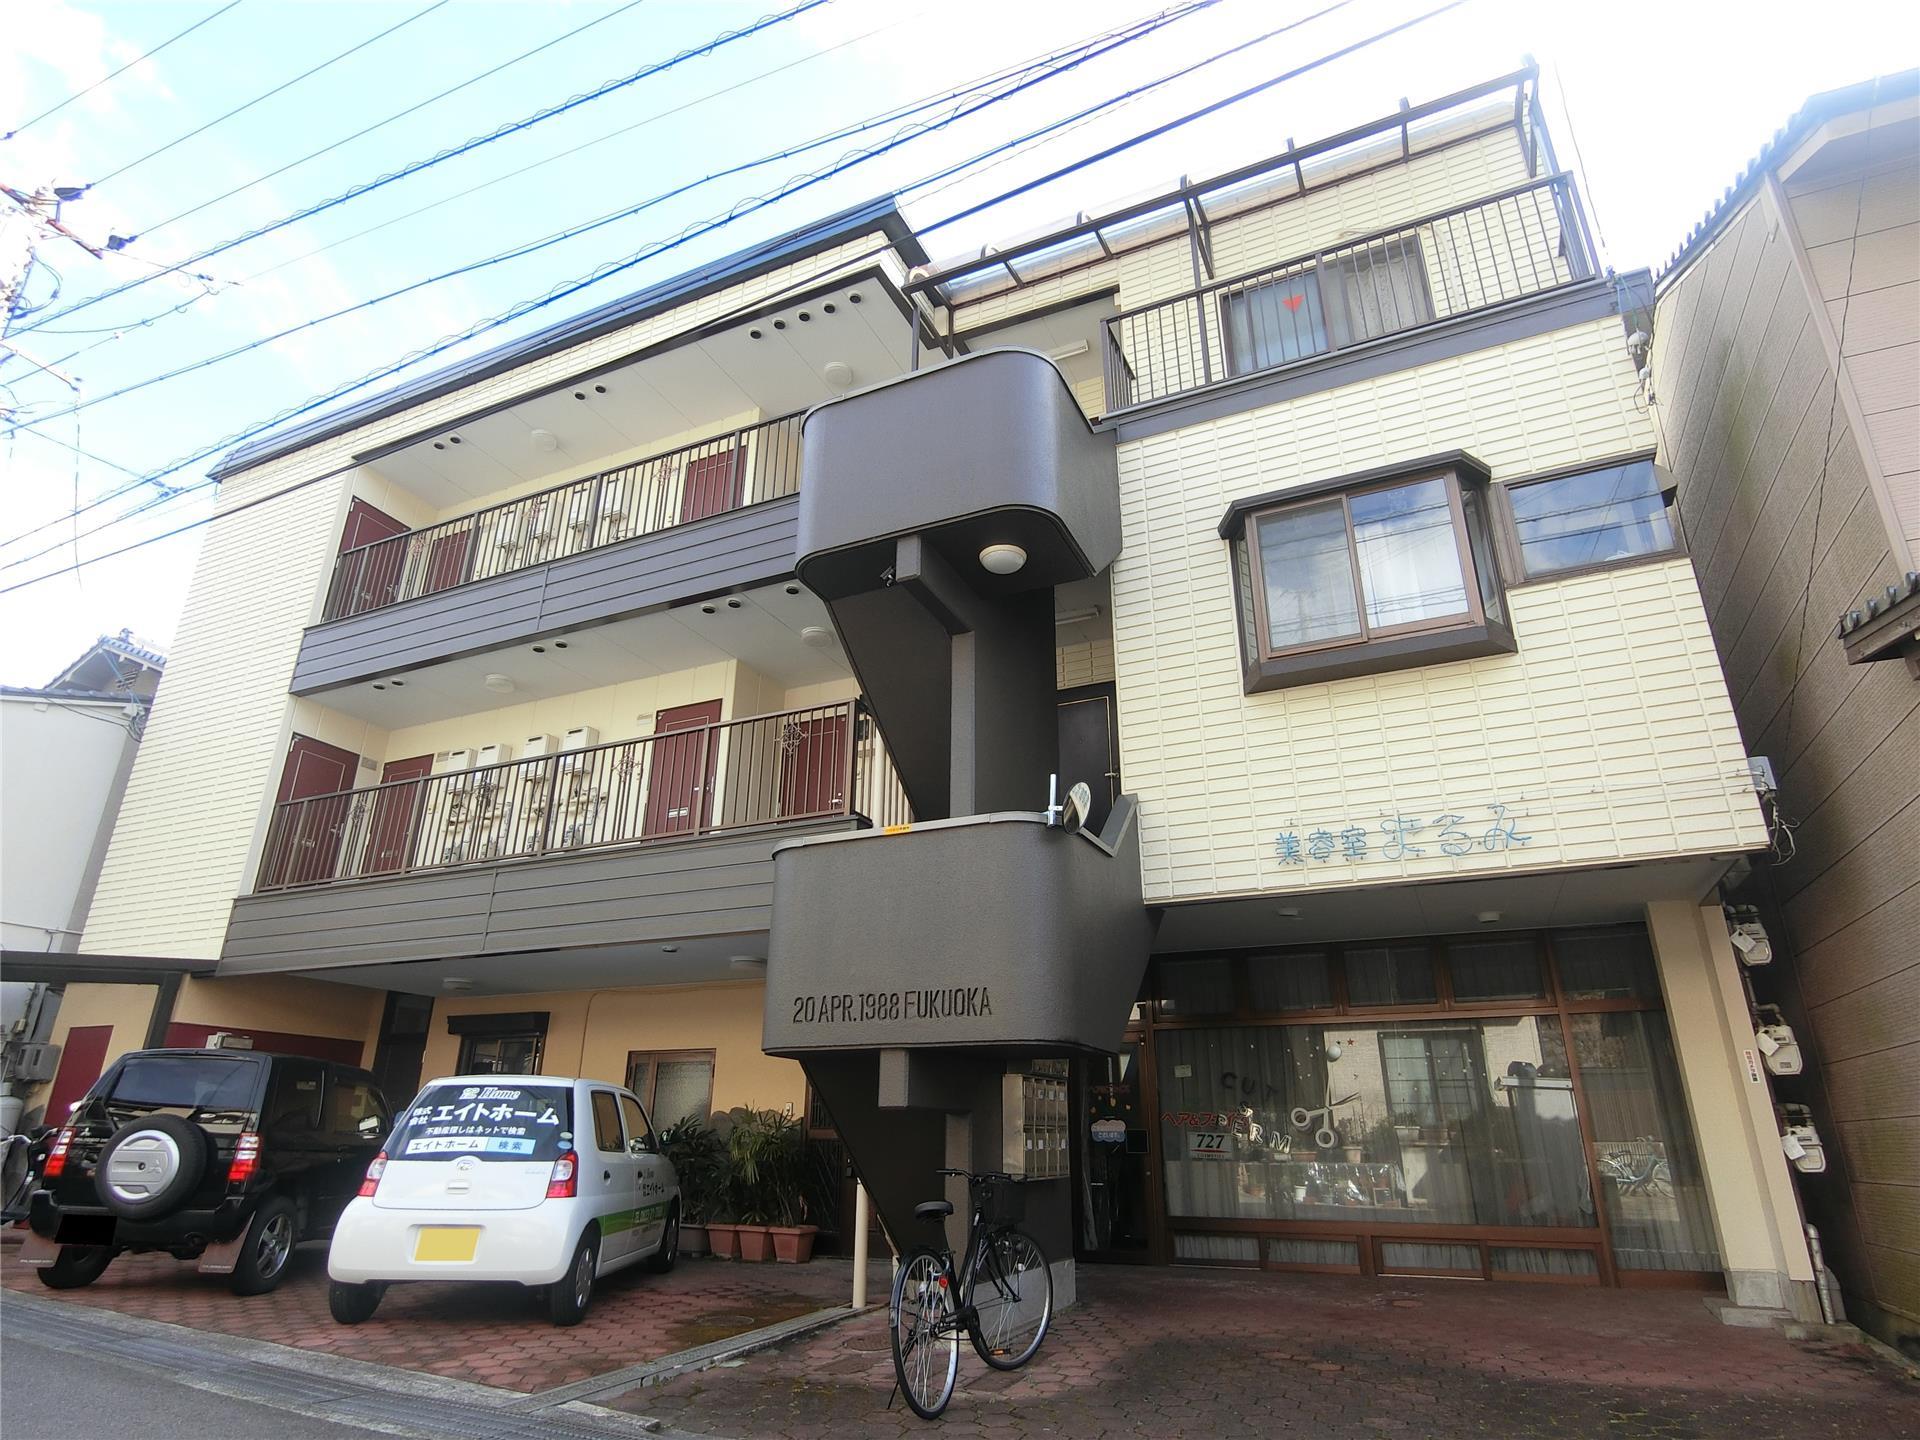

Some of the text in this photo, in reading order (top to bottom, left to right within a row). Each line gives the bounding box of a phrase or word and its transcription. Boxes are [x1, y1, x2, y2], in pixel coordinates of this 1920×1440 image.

[793, 996, 815, 1024] 20
[904, 987, 992, 1019] FUKUOKA
[477, 1086, 521, 1100] Home
[431, 1102, 560, 1126] エイトホーム
[410, 1138, 523, 1151] エイトホーム 検索
[1197, 1133, 1225, 1149] 727
